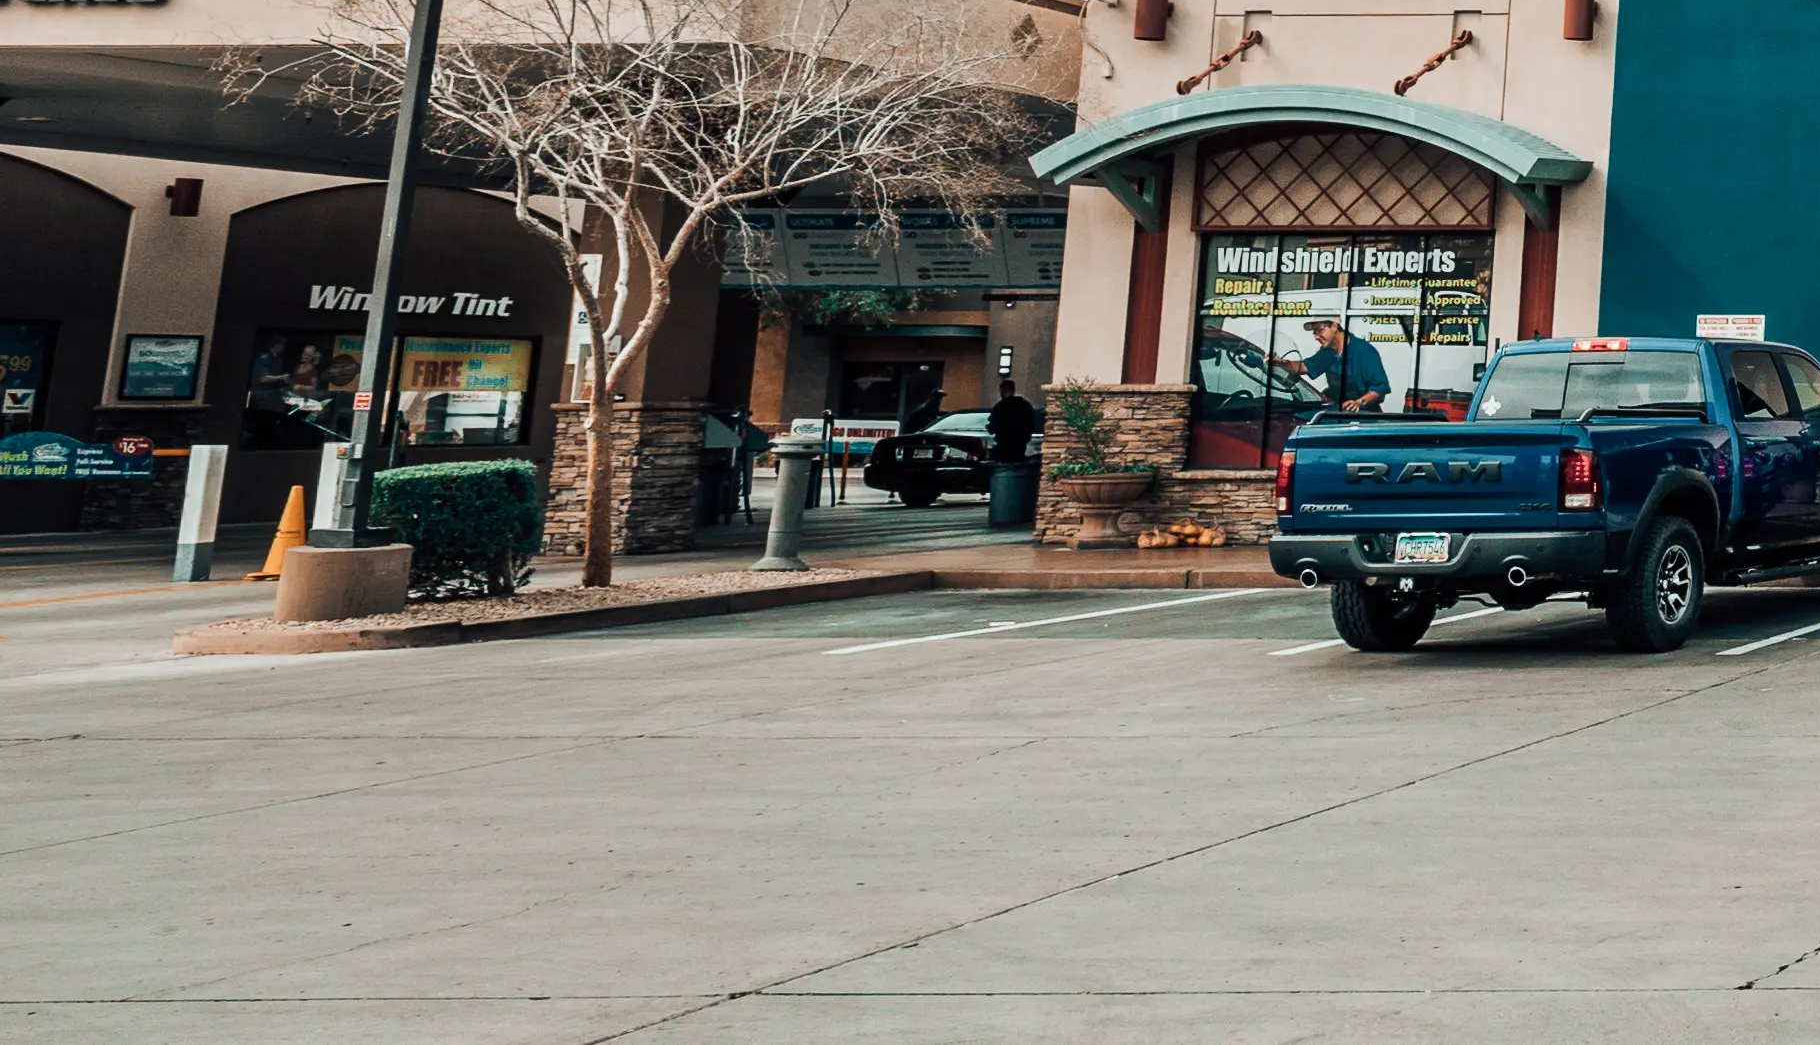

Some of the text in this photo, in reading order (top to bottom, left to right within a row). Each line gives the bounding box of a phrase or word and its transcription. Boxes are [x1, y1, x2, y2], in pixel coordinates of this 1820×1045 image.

[1217, 247, 1456, 275] Windshield Experts
[1215, 278, 1264, 295] Repair
[1371, 278, 1416, 288] Lifetime
[309, 285, 514, 317] Winow Tint
[1426, 295, 1481, 308] Approved
[1430, 332, 1471, 344] Repairs
[411, 360, 463, 387] FREE
[1346, 461, 1502, 484] RAM
